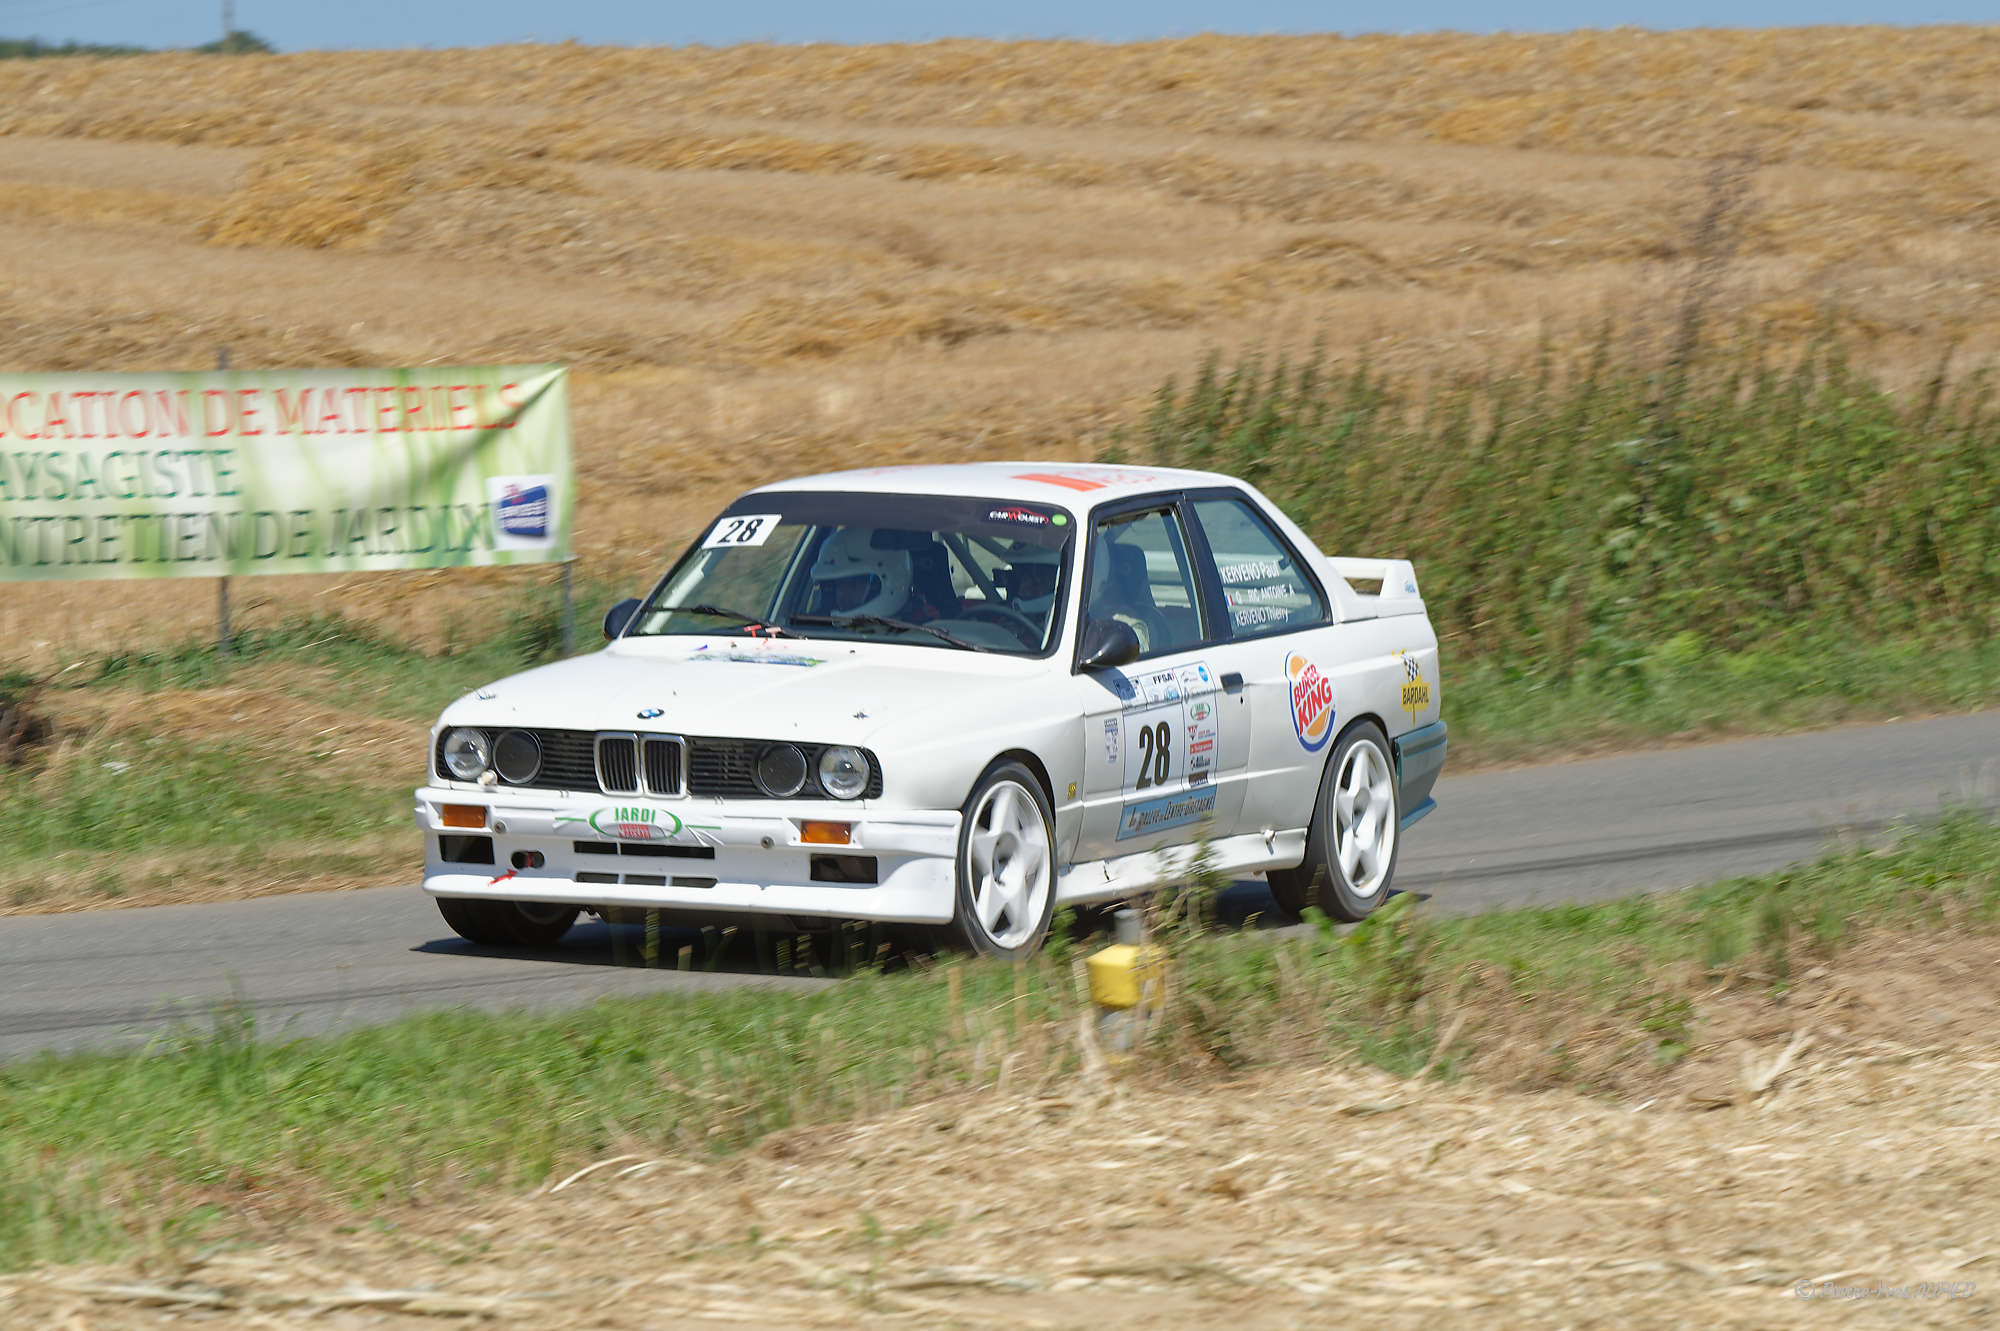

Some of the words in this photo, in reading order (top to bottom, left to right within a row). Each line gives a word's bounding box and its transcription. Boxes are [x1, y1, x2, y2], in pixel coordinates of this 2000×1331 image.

[0, 387, 190, 439] CATION
[202, 388, 263, 436] DE
[251, 508, 315, 563] DE
[717, 518, 764, 543] 28
[1220, 562, 1260, 584] KERVENO
[1260, 560, 1280, 579] Paul
[1235, 608, 1266, 627] KERVENO
[1266, 605, 1288, 623] Thierry
[1152, 673, 1173, 685] FFSA
[1298, 677, 1332, 736] KING
[1402, 686, 1430, 705] BARDAHL
[1136, 721, 1171, 790] 28
